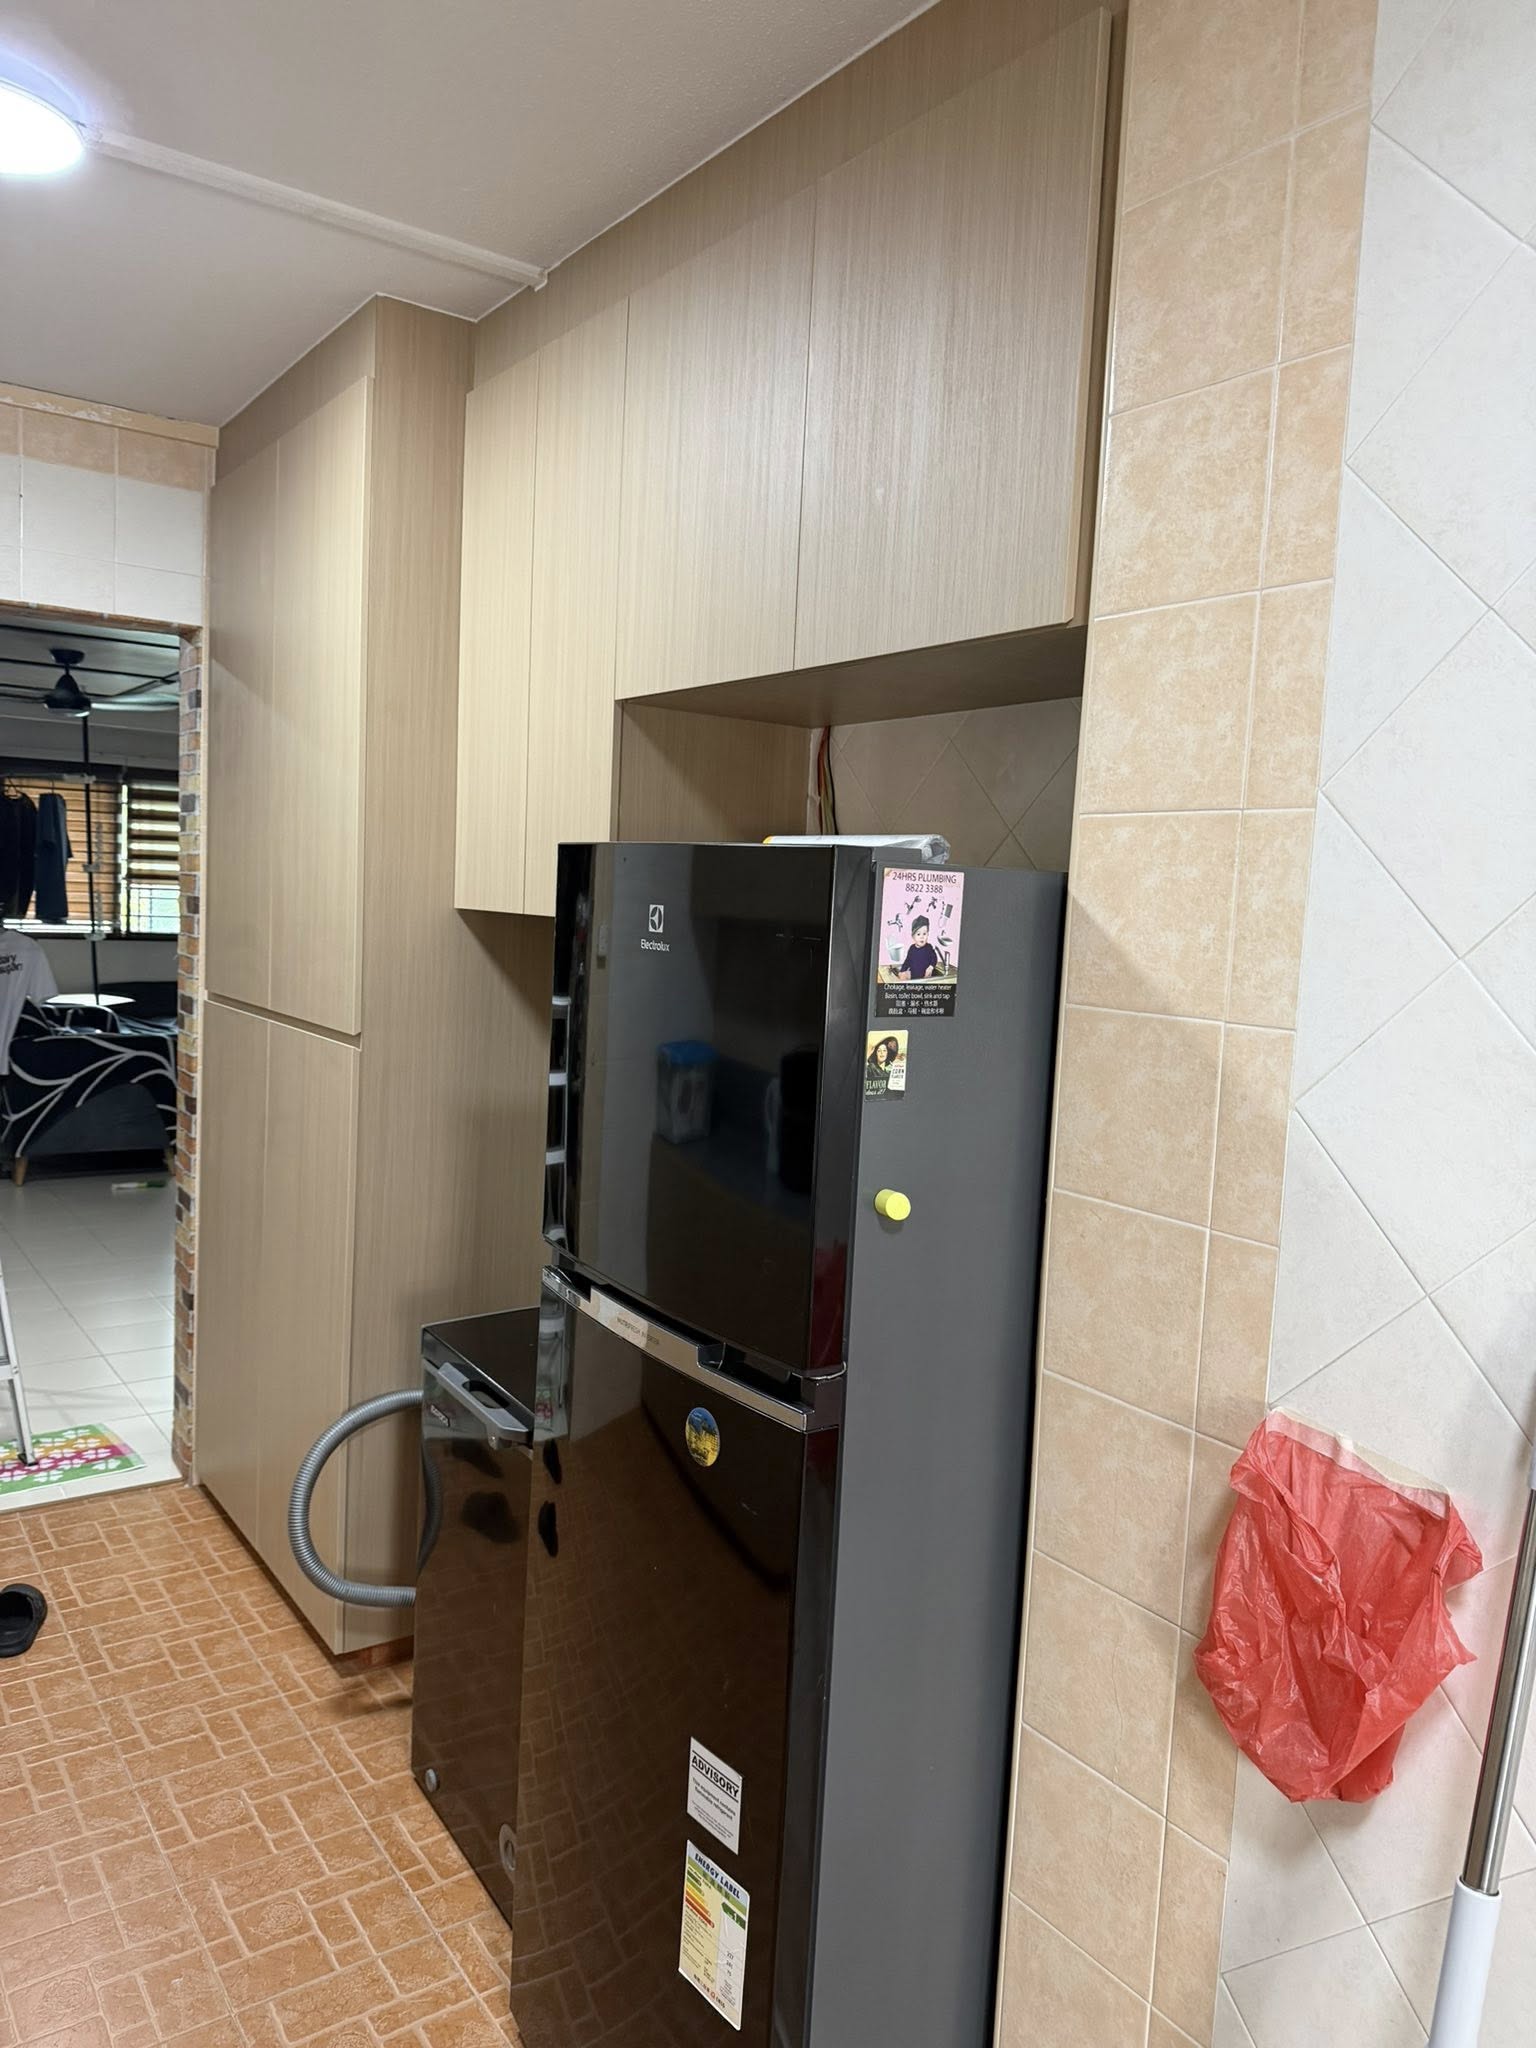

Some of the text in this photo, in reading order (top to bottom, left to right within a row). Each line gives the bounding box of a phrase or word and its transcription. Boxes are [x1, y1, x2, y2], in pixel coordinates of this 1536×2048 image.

[892, 871, 957, 884] 24HRS PLUMBING
[905, 883, 944, 893] 8822 3388
[640, 938, 670, 951] Electrolux
[866, 1080, 886, 1090] FLAVOR
[692, 1755, 739, 1798] ADVISORY
[694, 1852, 719, 1879] ENERGY
[720, 1876, 740, 1899] LABEL
